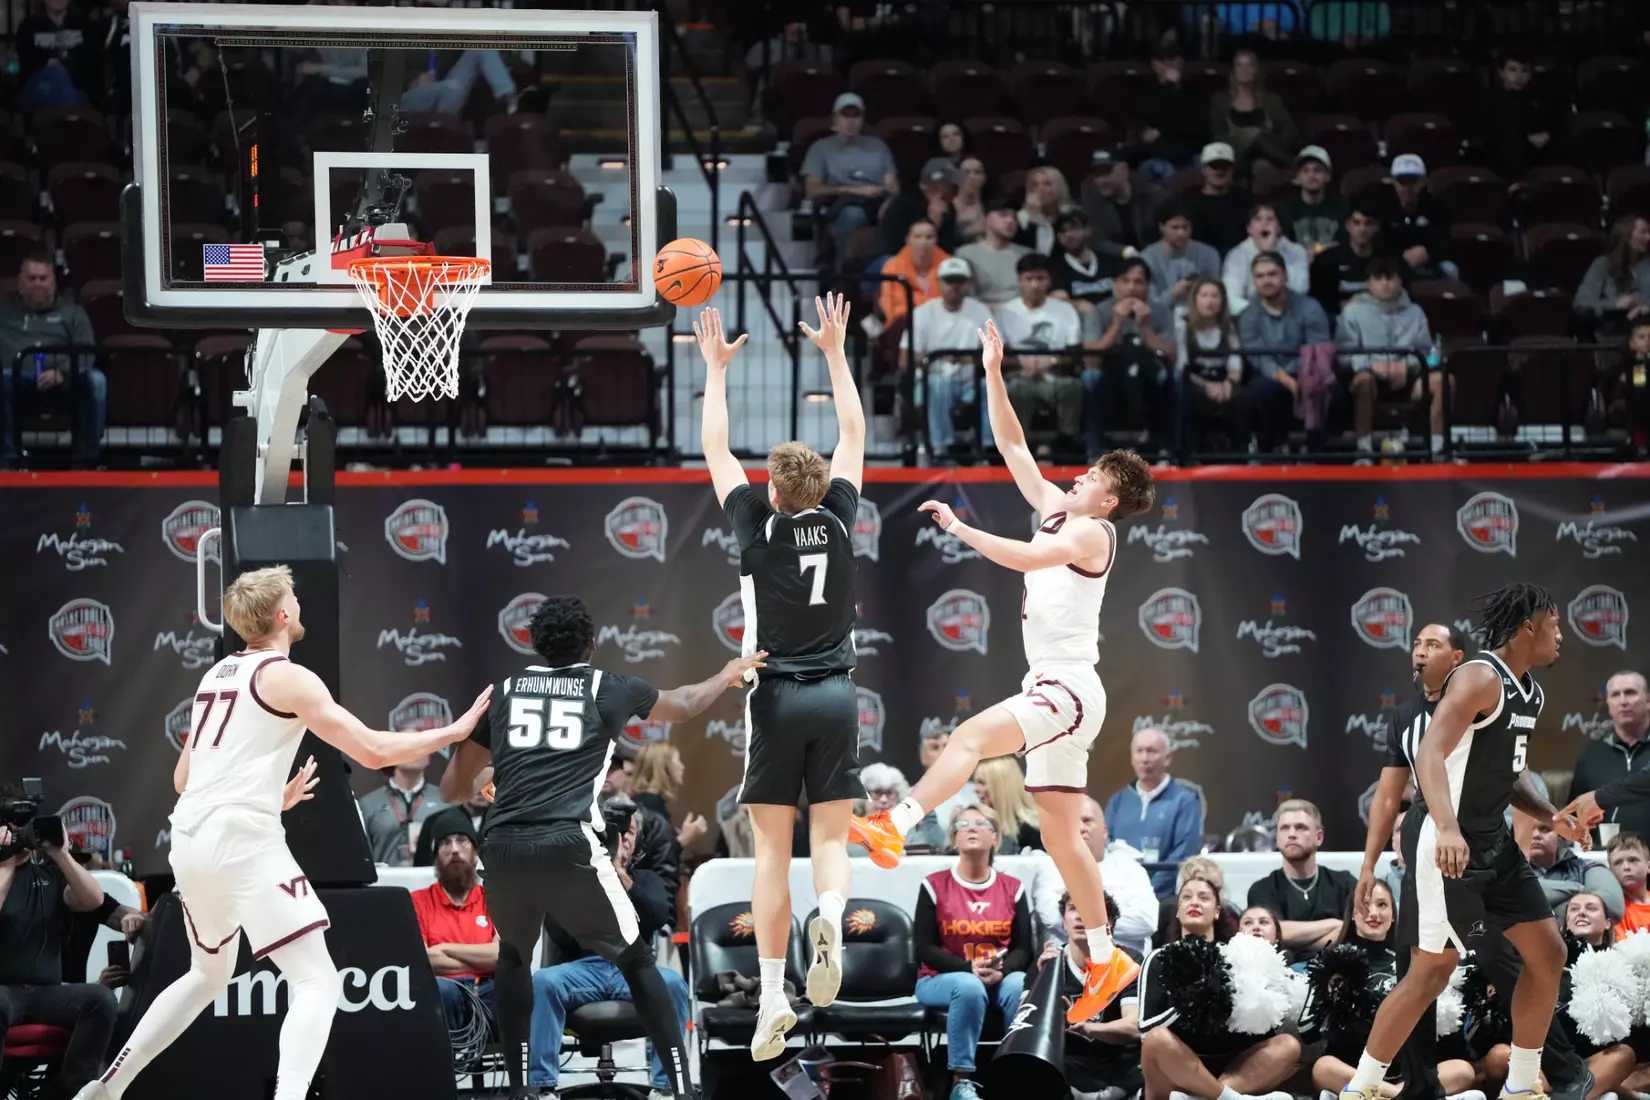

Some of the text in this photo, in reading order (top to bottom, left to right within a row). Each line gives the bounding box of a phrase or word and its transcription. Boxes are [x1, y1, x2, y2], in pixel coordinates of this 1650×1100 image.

[793, 525, 828, 547] VAAKS
[799, 552, 829, 606] 7
[514, 676, 585, 697] ERHUNMWUNSE
[191, 689, 239, 751] 77
[507, 695, 585, 751] 55
[1512, 734, 1527, 772] 5
[967, 900, 991, 915] VT
[942, 919, 1012, 937] HOKIES
